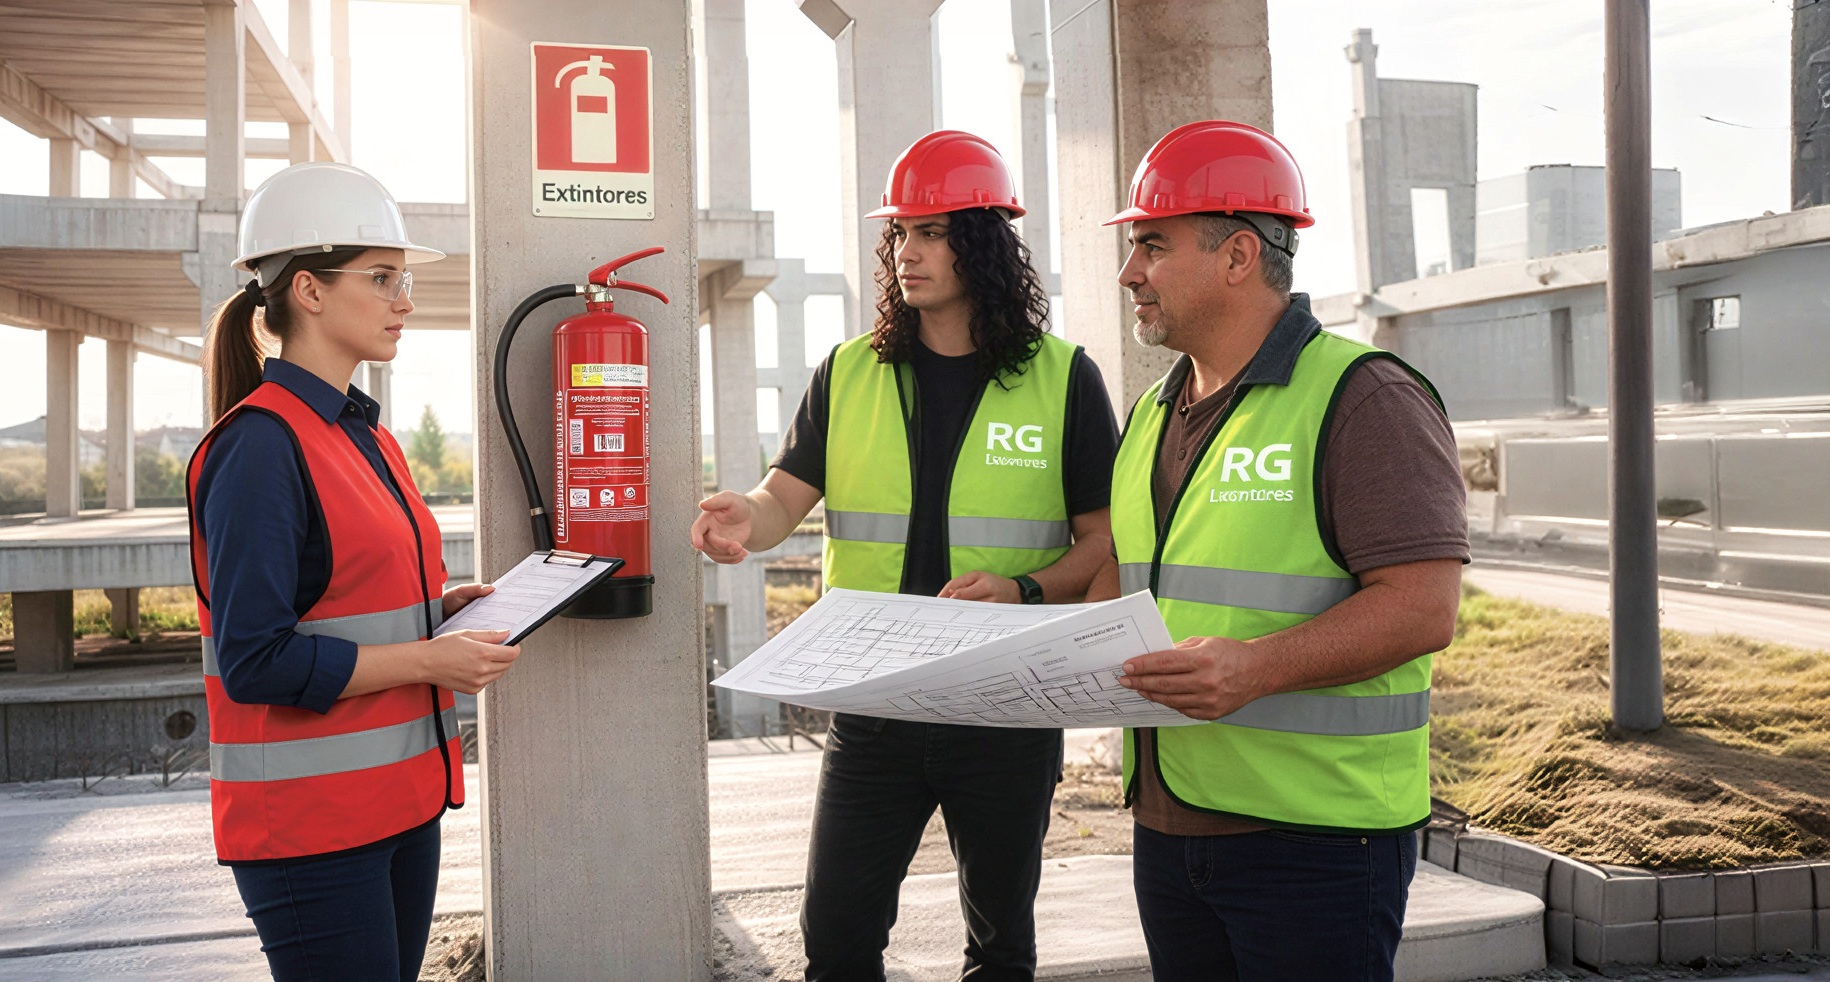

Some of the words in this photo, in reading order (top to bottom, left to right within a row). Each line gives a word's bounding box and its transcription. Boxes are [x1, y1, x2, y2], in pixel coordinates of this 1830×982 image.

[542, 182, 647, 204] Extintores
[986, 422, 1043, 452] RG
[1220, 443, 1292, 482] RG
